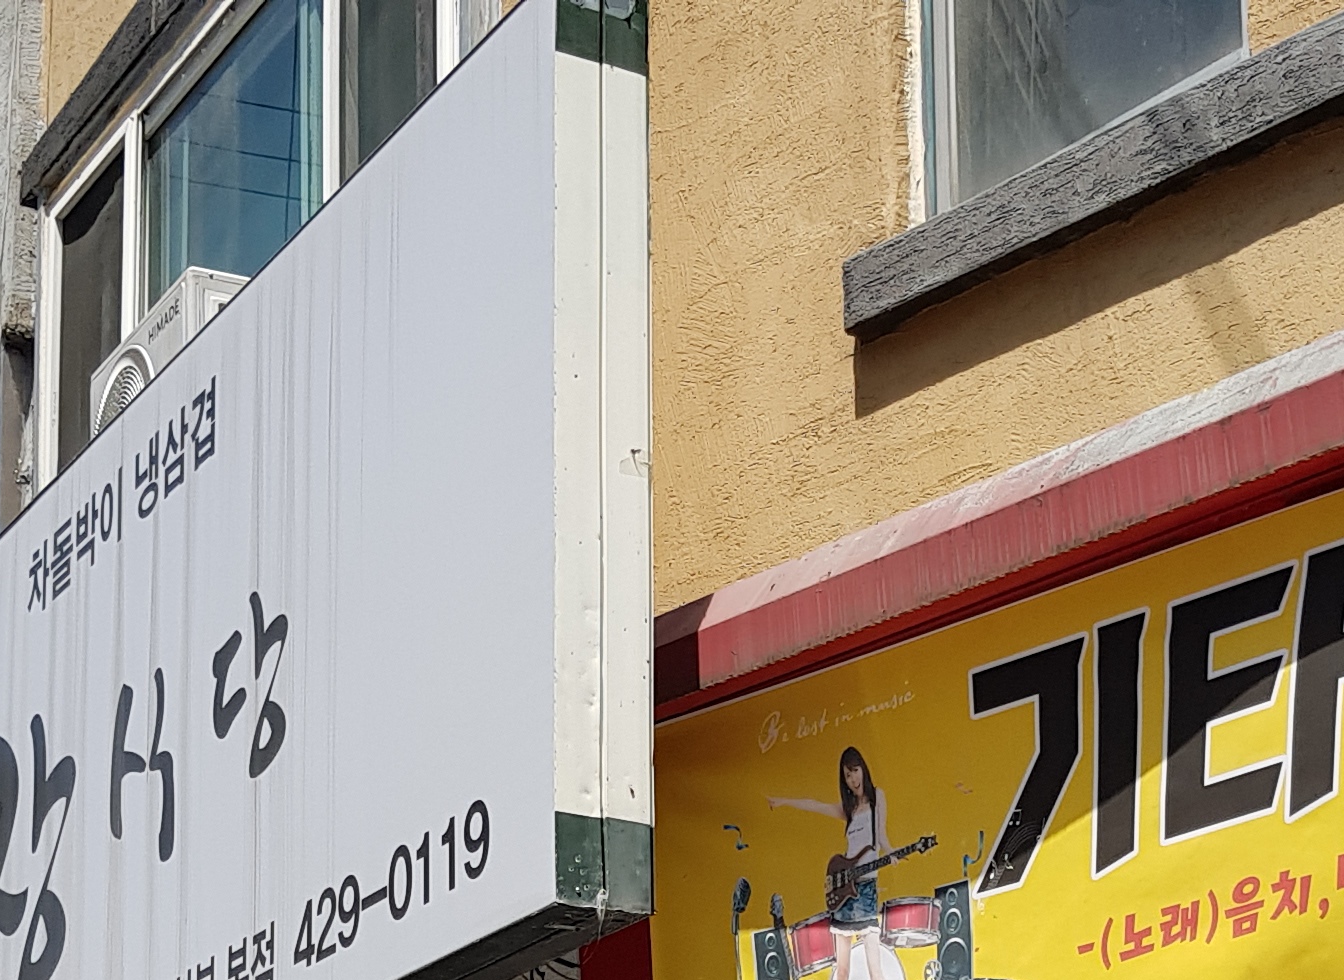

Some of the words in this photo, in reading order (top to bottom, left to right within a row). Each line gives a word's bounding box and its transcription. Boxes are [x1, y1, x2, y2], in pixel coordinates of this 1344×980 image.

[28, 466, 123, 612] 차돌박이
[135, 375, 217, 519] 냉삼겹
[293, 800, 490, 967] 429-0119
